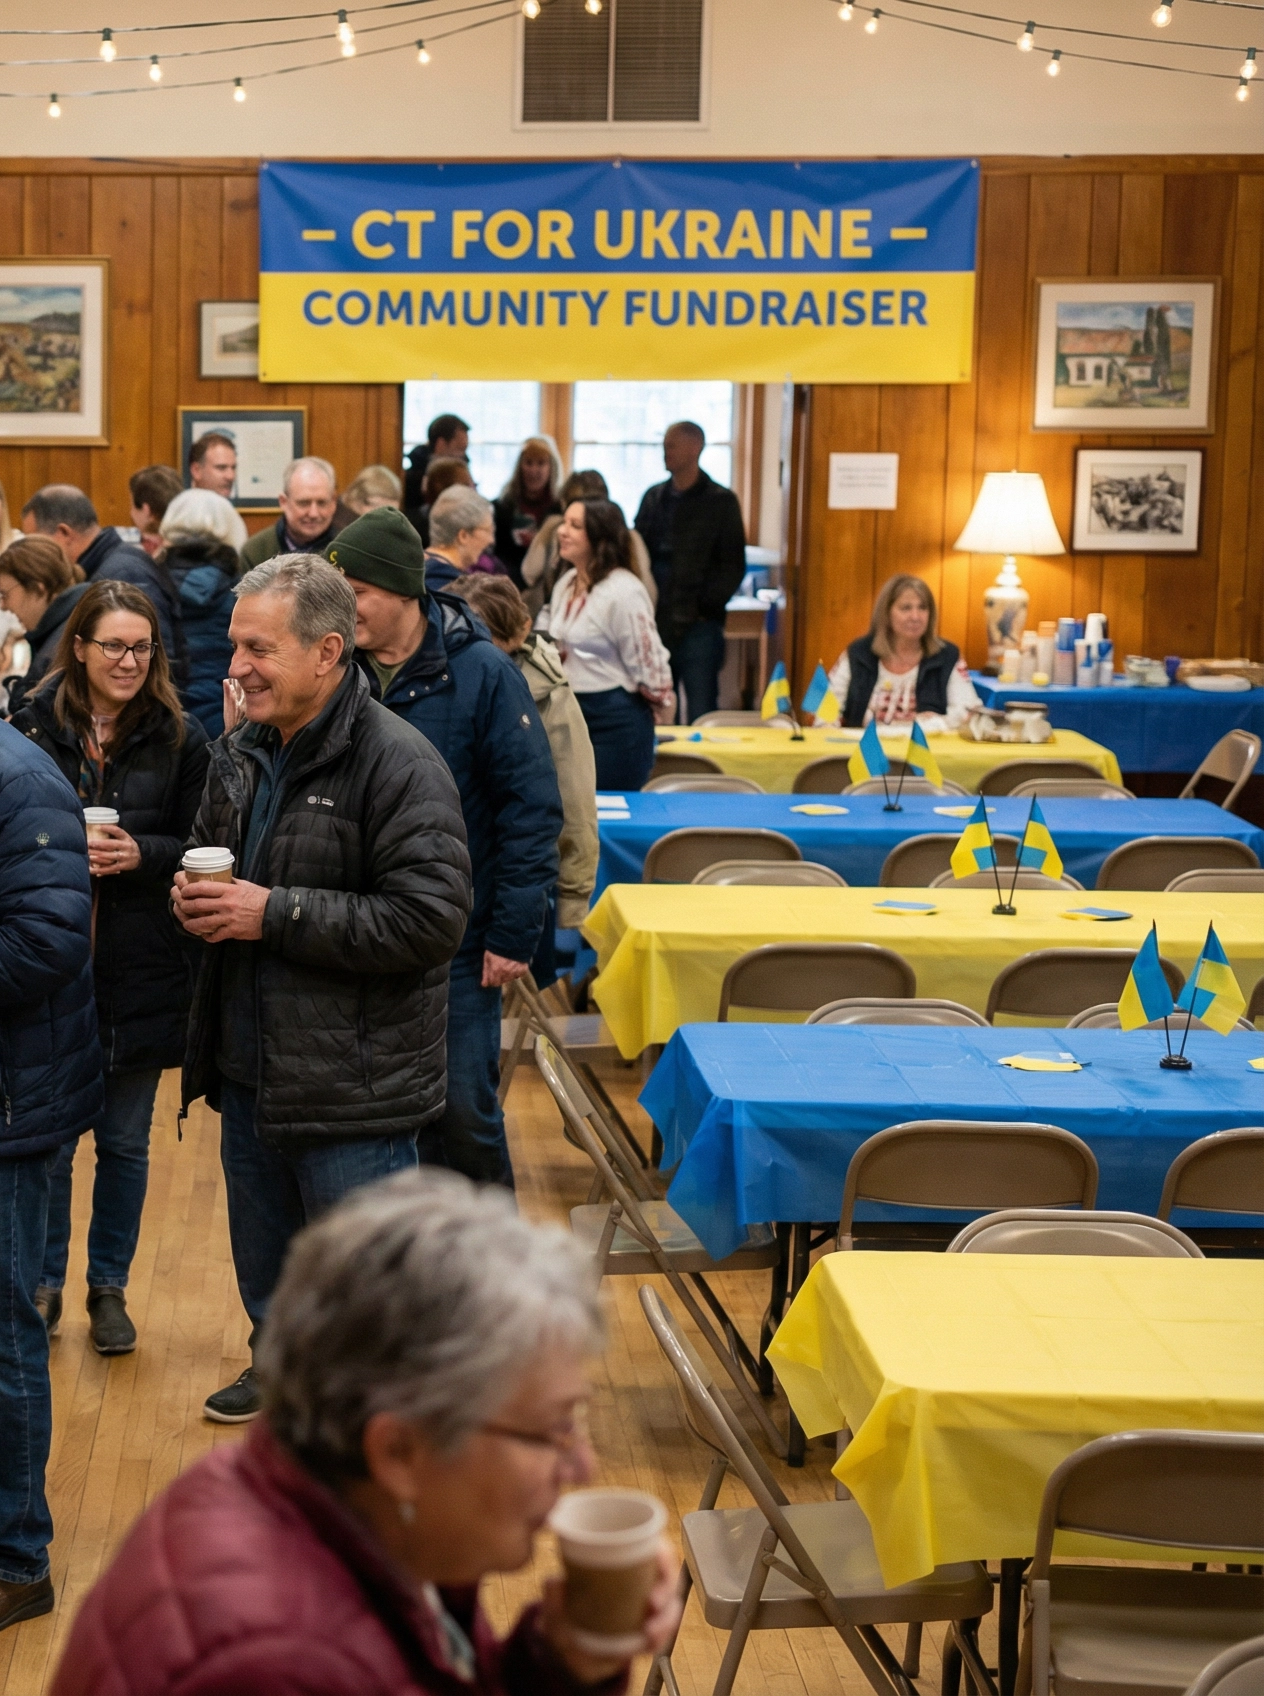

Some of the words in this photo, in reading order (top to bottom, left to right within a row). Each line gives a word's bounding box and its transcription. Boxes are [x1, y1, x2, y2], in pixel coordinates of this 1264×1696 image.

[351, 208, 436, 260] CT
[452, 208, 576, 260] FOR
[593, 208, 873, 260] UKRAINE
[302, 289, 610, 328] COMMUNITY
[623, 289, 928, 328] FUNDRAISER
